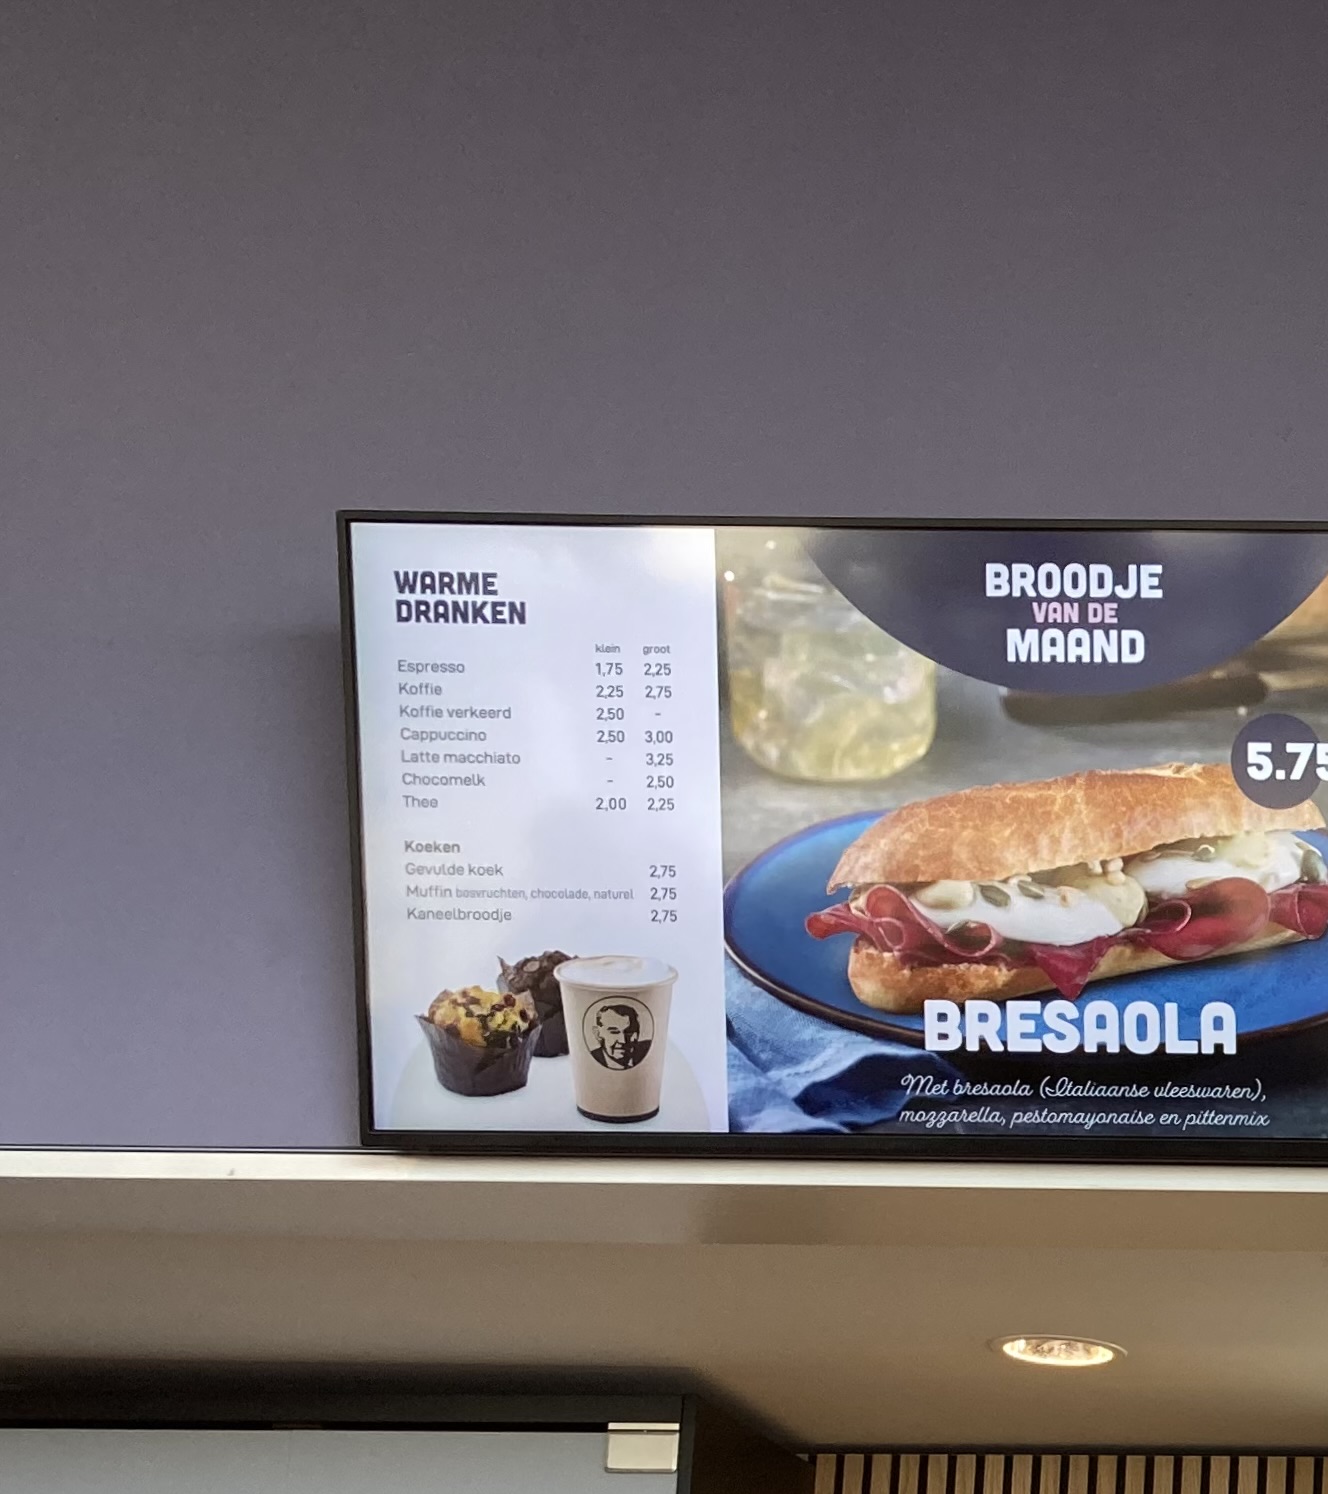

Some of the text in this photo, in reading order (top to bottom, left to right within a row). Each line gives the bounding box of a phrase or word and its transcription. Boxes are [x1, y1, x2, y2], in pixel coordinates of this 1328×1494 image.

[394, 570, 498, 596] WARME
[985, 563, 1163, 599] BROODJE
[396, 600, 526, 625] DRANKEN
[1032, 603, 1117, 624] VAN DE
[1007, 629, 1145, 663] MAAND
[399, 682, 672, 700] Koffie 2,25 2,75
[400, 728, 673, 745] Cappuccino 2,50 3,00
[405, 841, 460, 853] Koeken
[407, 908, 677, 923] Kaneelbroodje 2,75
[924, 1000, 1237, 1054] BRESAOLA
[900, 1075, 949, 1098] Met
[953, 1078, 1032, 1098] bresaola
[1155, 1079, 1267, 1102] vleeswaren),
[899, 1108, 1270, 1130] mozzarella, pestomayonaise en pittenmix
